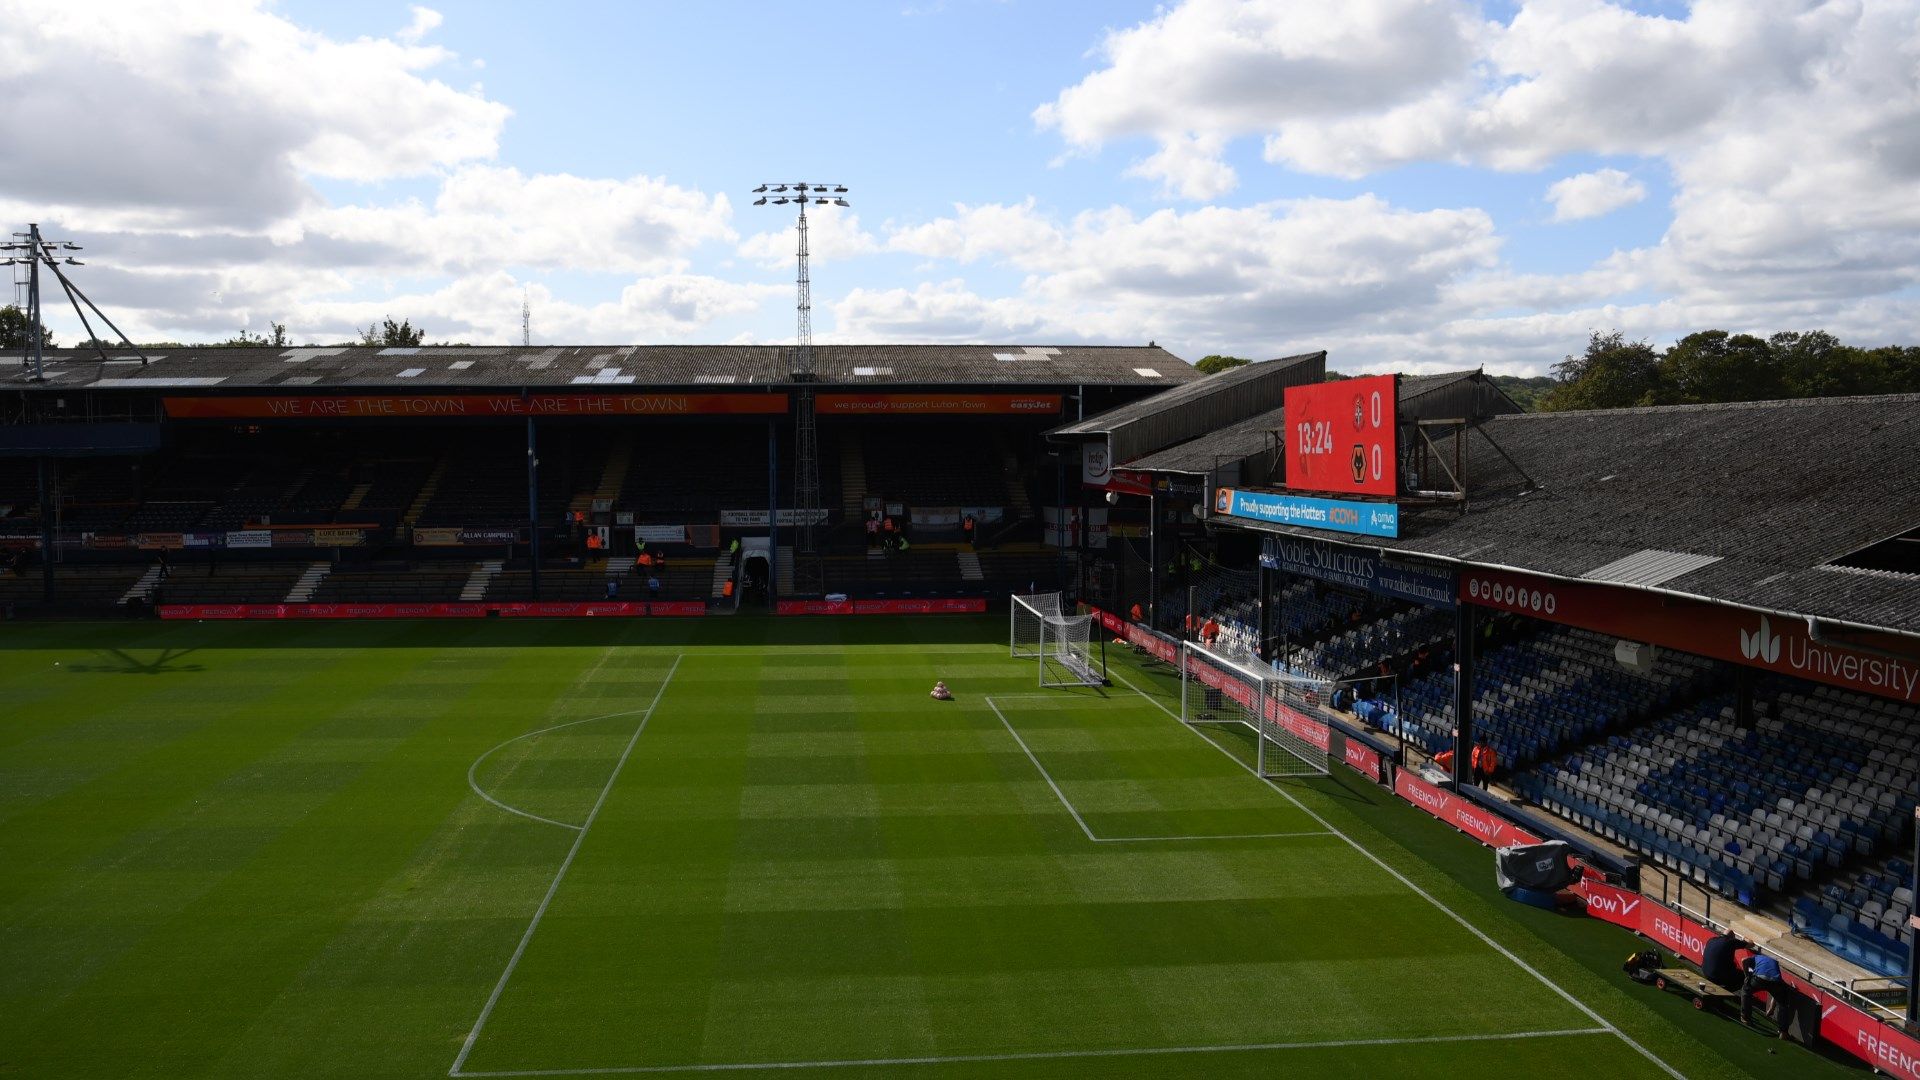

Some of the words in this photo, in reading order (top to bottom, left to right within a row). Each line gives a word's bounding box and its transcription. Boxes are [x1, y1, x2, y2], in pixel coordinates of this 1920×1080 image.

[267, 399, 303, 414] WE
[309, 399, 349, 414] ARE
[353, 399, 395, 413] THE
[399, 399, 465, 413] TOWN
[487, 398, 522, 413] WE
[529, 398, 569, 412] ARE
[574, 397, 613, 411] THE
[620, 398, 687, 412] TOWN!
[833, 401, 849, 409] we
[851, 400, 888, 410] proudly
[890, 401, 928, 410] support
[931, 400, 958, 409] Luton
[960, 400, 986, 409] Town
[1010, 401, 1051, 410] easyJet
[1371, 391, 1381, 428] 0
[1297, 421, 1333, 454] 13:24
[1372, 443, 1382, 480] 0
[1240, 497, 1259, 517] Proudly
[1259, 502, 1289, 521] supporting
[1290, 503, 1301, 518] the
[1301, 504, 1326, 521] Hatters
[1329, 507, 1359, 527] #COYH
[1377, 512, 1394, 524] arriva
[463, 531, 482, 539] ALLAN
[483, 531, 514, 539] CAMPBELL
[1275, 538, 1311, 566] Noble
[1312, 538, 1375, 579] Solicitors
[1789, 634, 1919, 700] University
[1408, 783, 1439, 808] FREENOW
[1456, 808, 1492, 835] FREENOW
